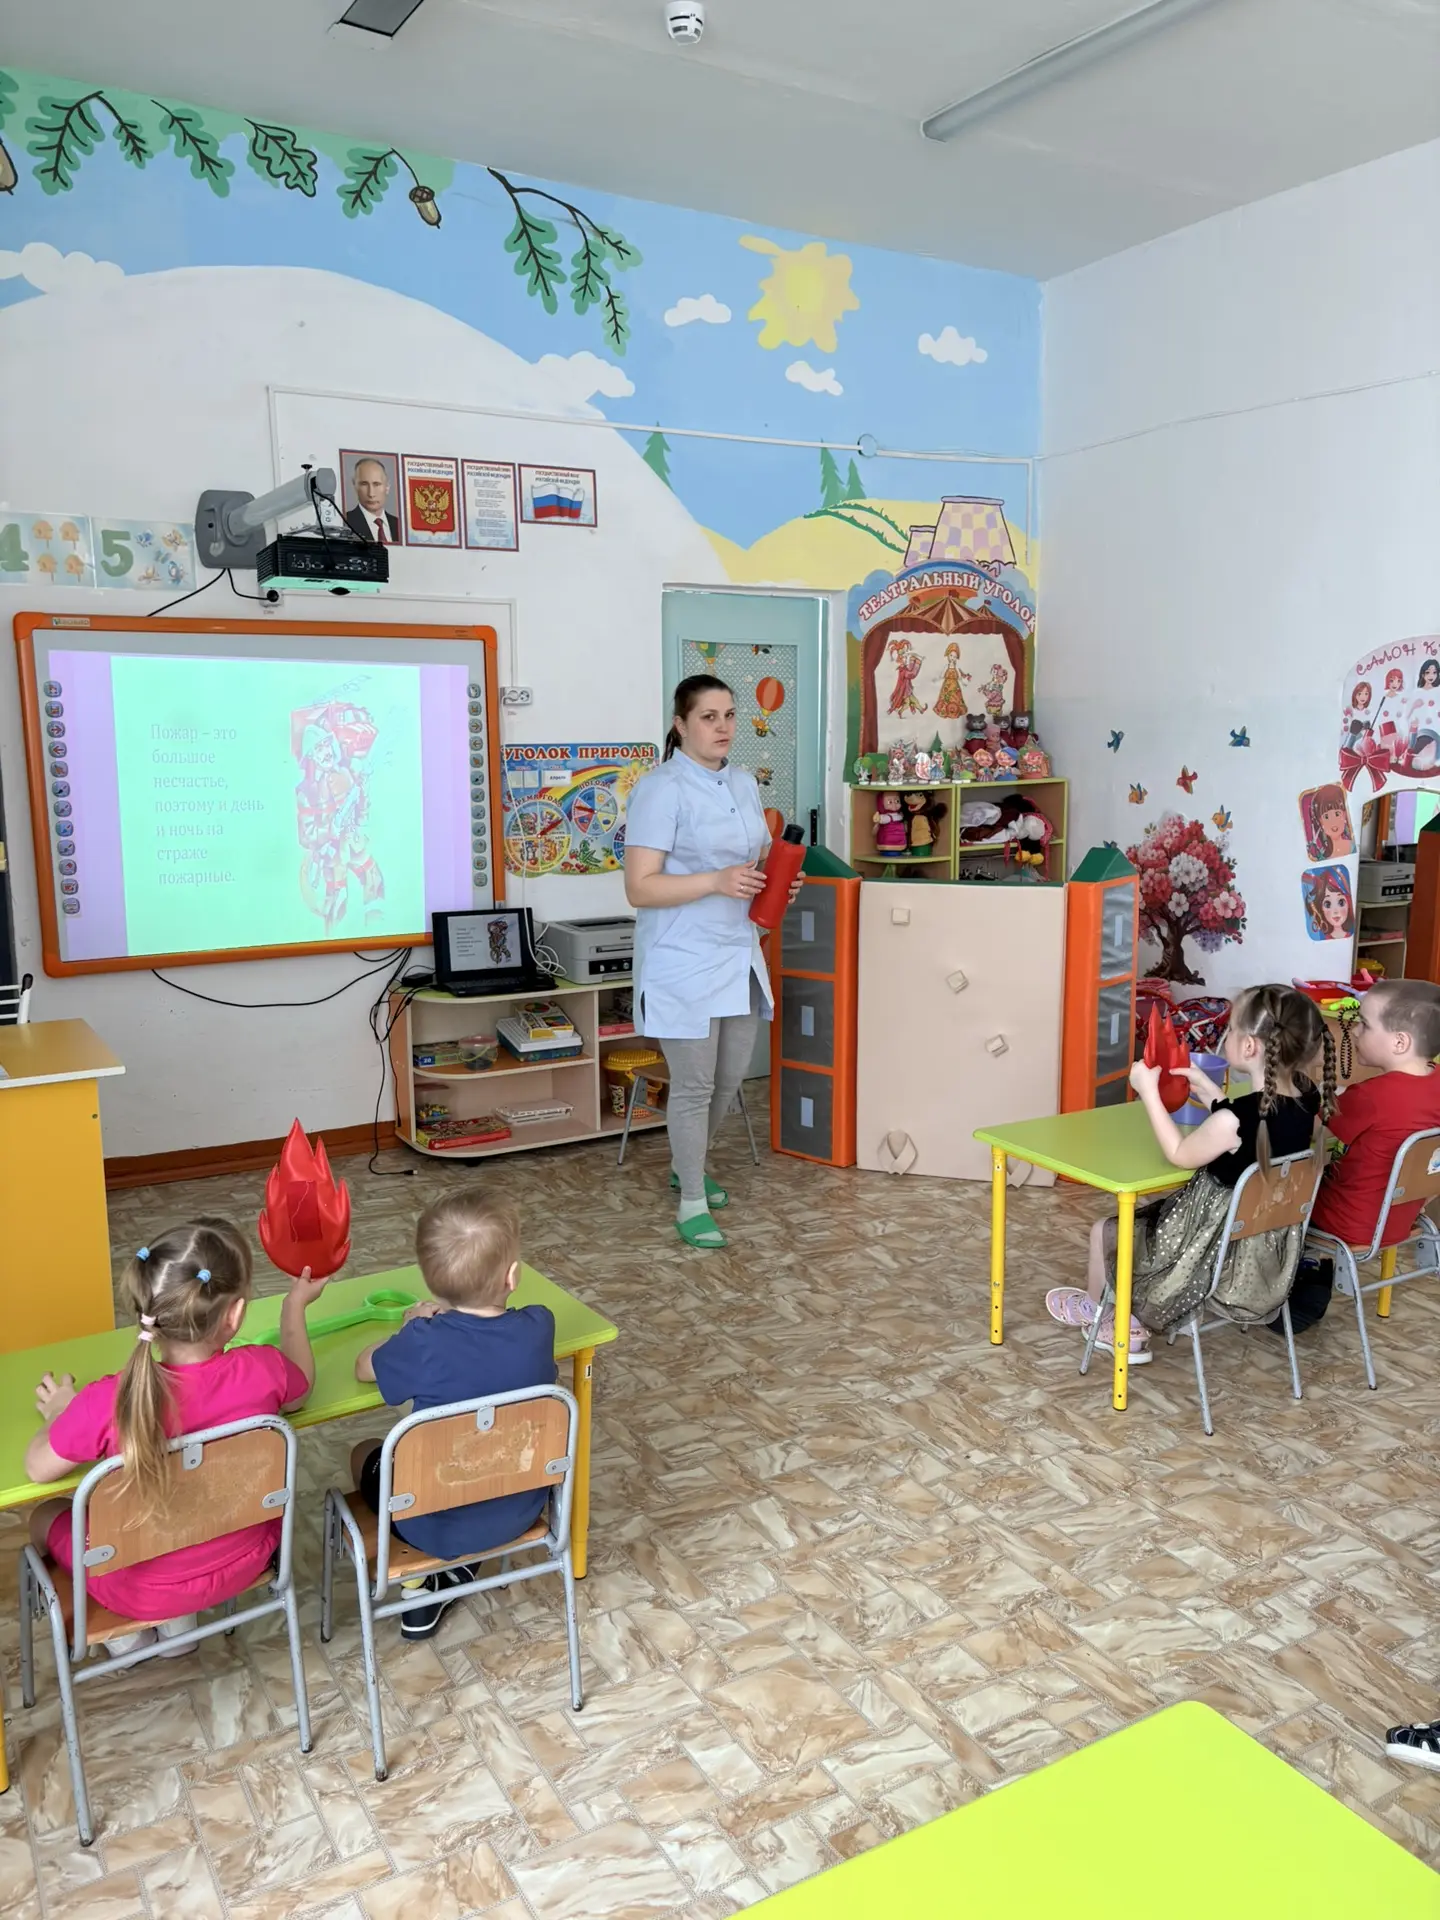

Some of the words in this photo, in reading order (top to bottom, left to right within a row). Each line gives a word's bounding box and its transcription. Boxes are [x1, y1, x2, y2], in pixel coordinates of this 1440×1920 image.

[0, 523, 29, 572] 4
[100, 529, 134, 577] 5
[859, 572, 981, 620] ТЕАТРАЛЬНЫЙ
[1356, 643, 1416, 676] САЛОН
[1423, 640, 1440, 656] К
[151, 724, 198, 743] Пожар
[213, 728, 237, 740] это
[152, 748, 216, 764] большое
[504, 746, 571, 759] УГОЛОК
[579, 746, 655, 758] ПРИРОДЫ
[153, 775, 228, 791] несчастье,
[155, 800, 214, 815] поэтому
[218, 800, 227, 812] и
[230, 800, 264, 813] день
[513, 794, 539, 808] РЕМЯ
[156, 825, 165, 837] и
[169, 824, 204, 837] ночь
[207, 823, 224, 836] на
[157, 847, 207, 864] страже
[159, 870, 235, 887] пожарные.
